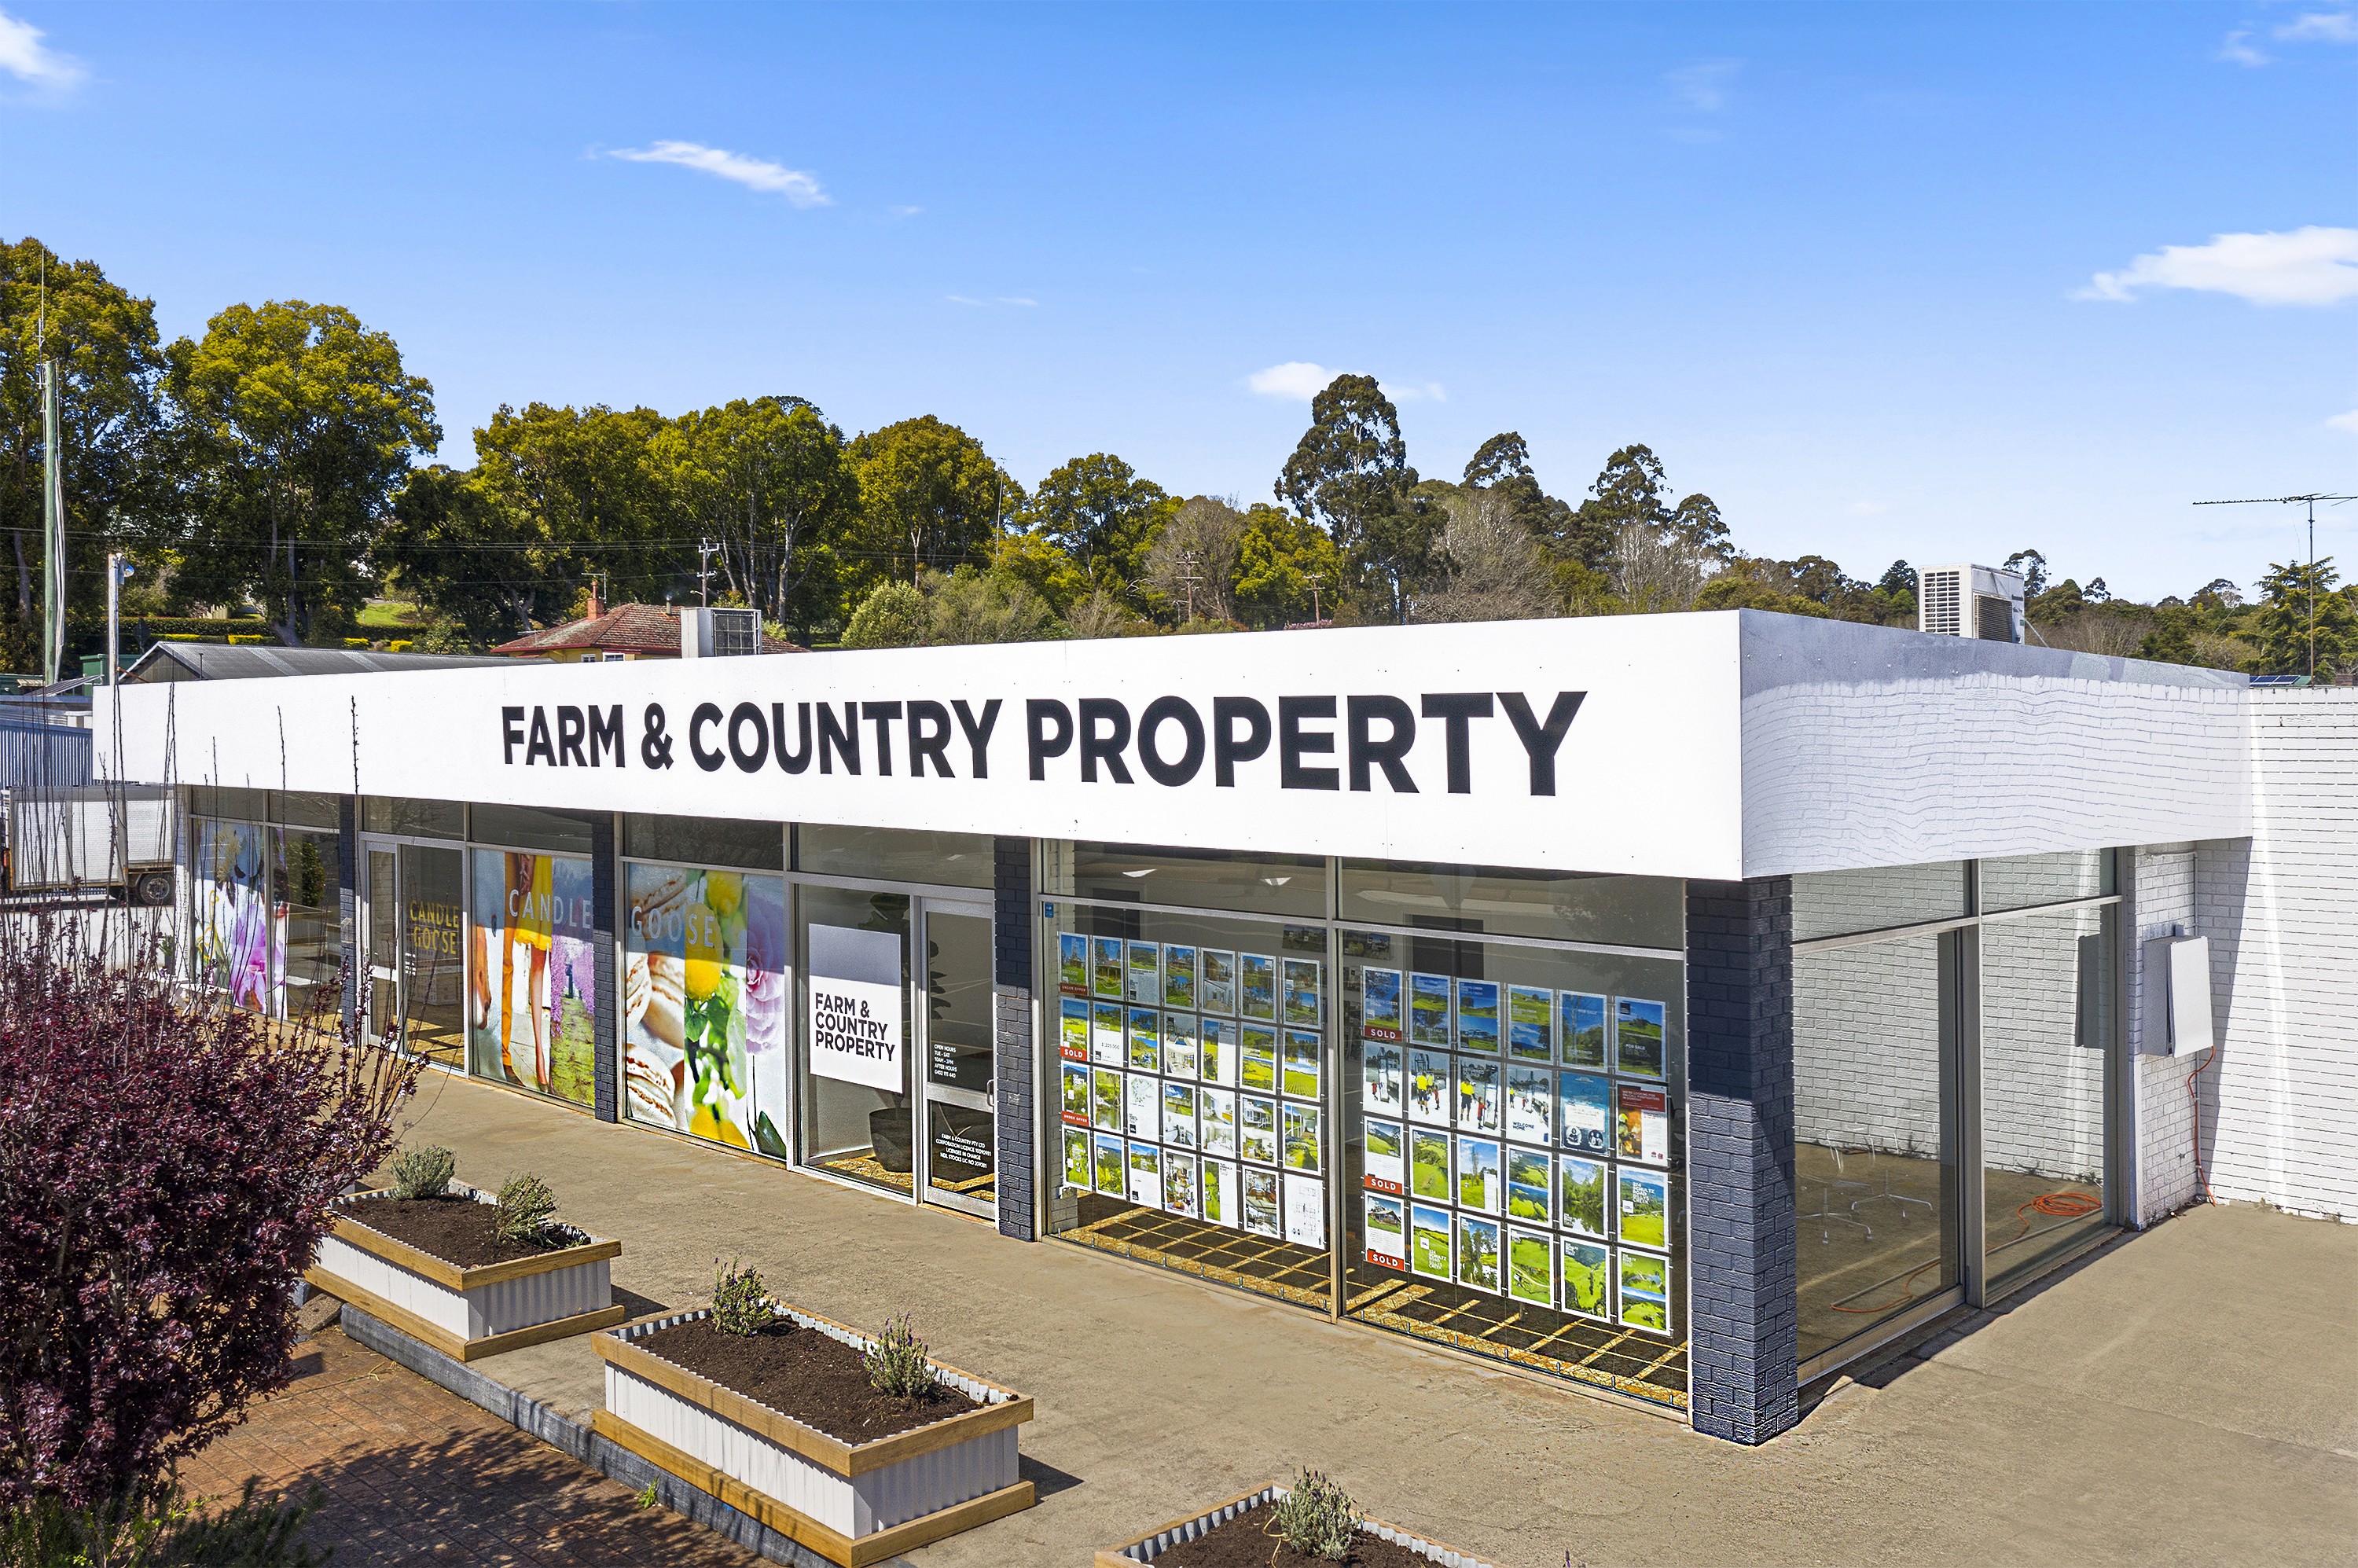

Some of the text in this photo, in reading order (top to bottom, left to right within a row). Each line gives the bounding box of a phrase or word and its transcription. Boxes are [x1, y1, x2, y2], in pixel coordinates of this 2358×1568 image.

[501, 690, 1589, 797] FARM & COUNTRY PROPERTY
[410, 900, 460, 927] CANDLE
[509, 889, 591, 929] CANDLE
[631, 905, 714, 948] GOOSE
[815, 993, 869, 1018] FARM &
[815, 1012, 888, 1041] COUNTRY
[1371, 1028, 1396, 1039] SOLD
[815, 1030, 895, 1062] PROPERTY
[1064, 1048, 1083, 1058] SOLD
[935, 1138, 960, 1148] CORPORATION
[955, 1137, 971, 1145] COUNTRY
[1371, 1178, 1396, 1191] SOLD
[1372, 1254, 1398, 1267] SOLD
